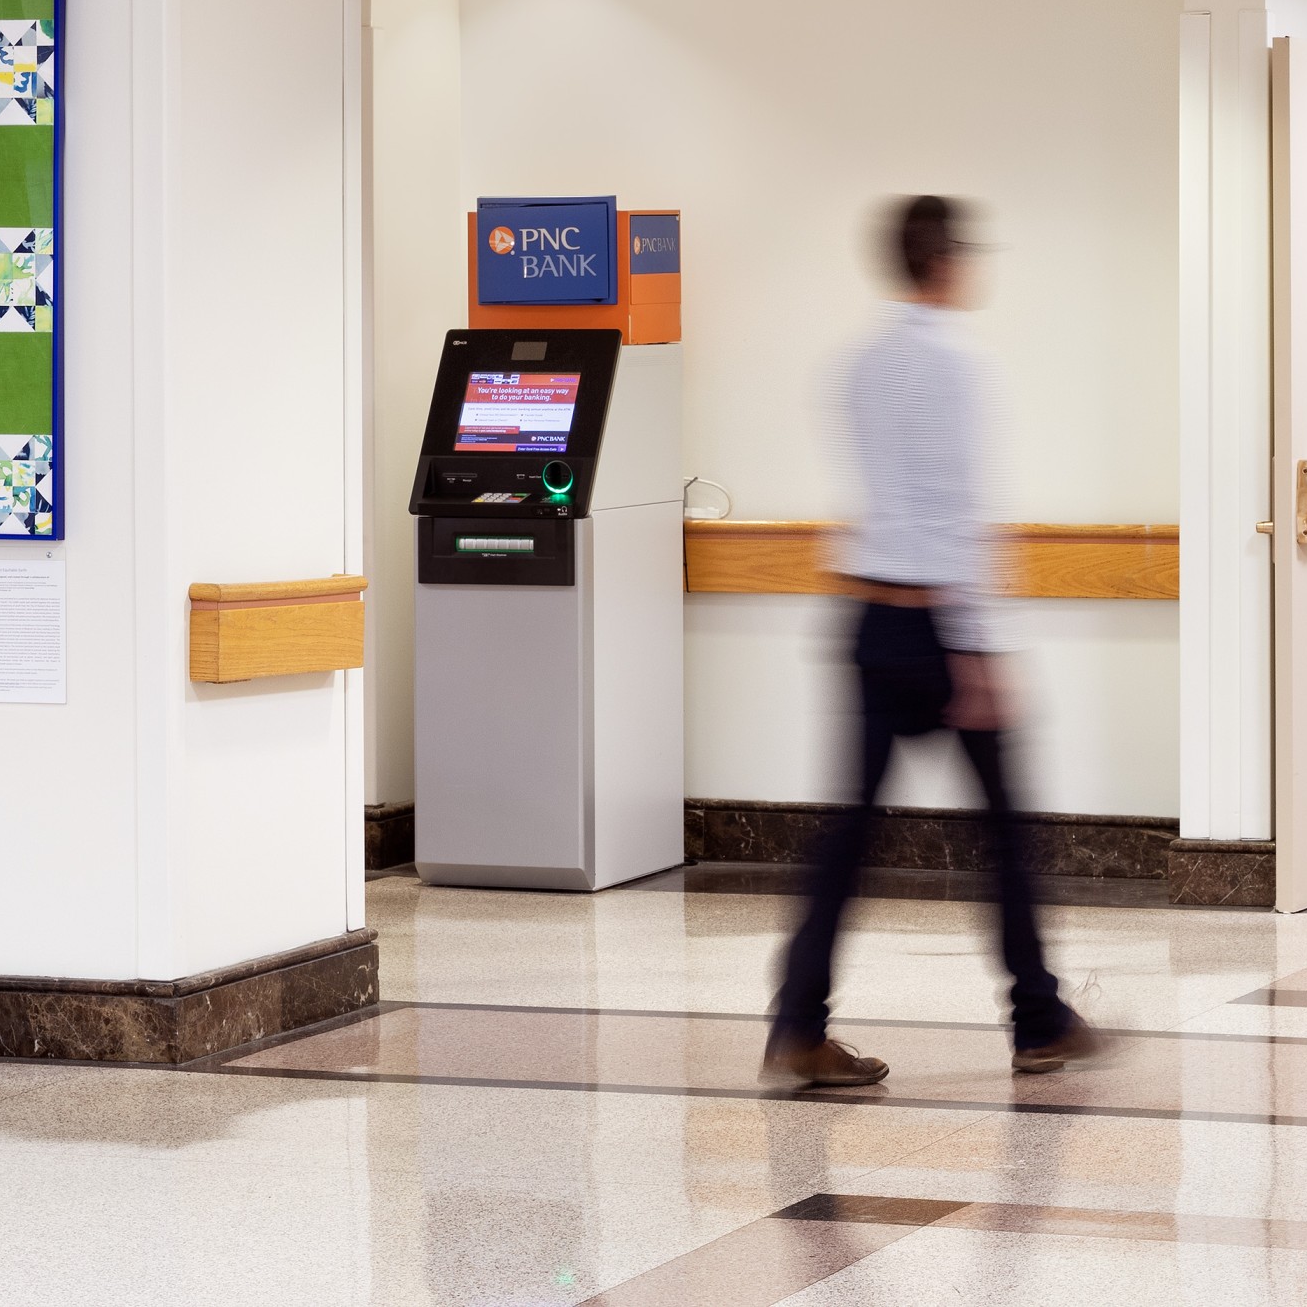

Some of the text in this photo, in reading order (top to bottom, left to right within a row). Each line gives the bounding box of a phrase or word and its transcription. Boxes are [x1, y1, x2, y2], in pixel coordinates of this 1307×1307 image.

[518, 225, 581, 252] PNC
[519, 253, 597, 279] BANK
[498, 387, 522, 395] looking
[523, 394, 552, 402] banking.
